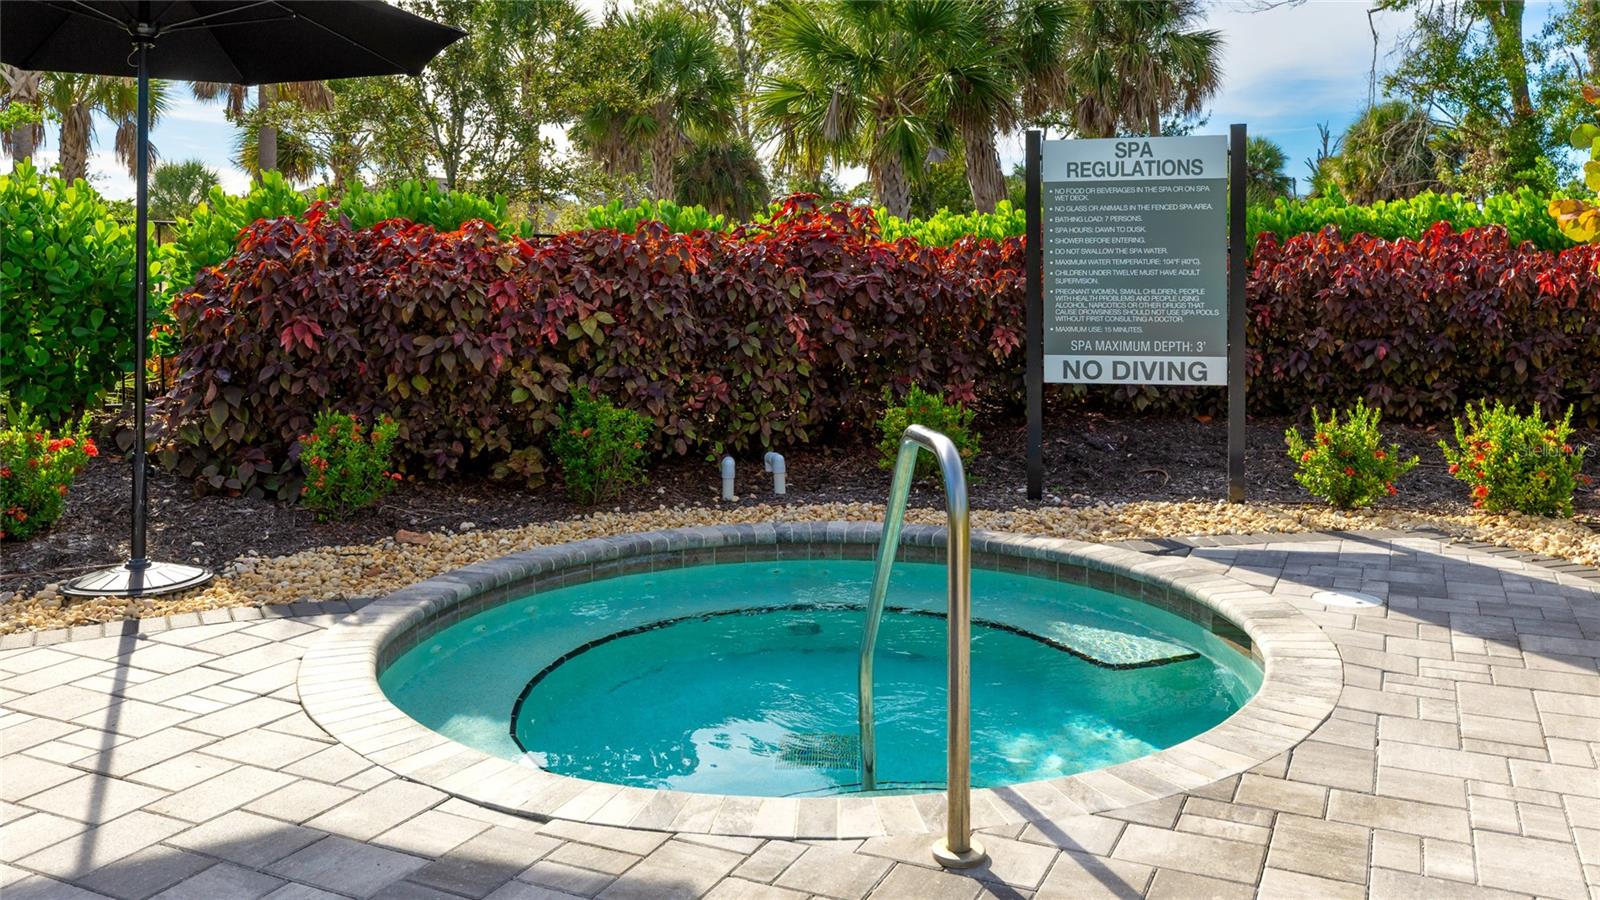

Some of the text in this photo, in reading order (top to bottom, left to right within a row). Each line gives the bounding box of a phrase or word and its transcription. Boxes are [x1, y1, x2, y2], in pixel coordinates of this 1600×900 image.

[1115, 142, 1153, 158] SPA
[1066, 159, 1204, 178] REGULATIONS
[1070, 340, 1092, 351] SPA
[1096, 340, 1150, 352] MAXIMUM
[1154, 341, 1194, 352] DEPTH:
[1062, 360, 1208, 382] NO DIVING
